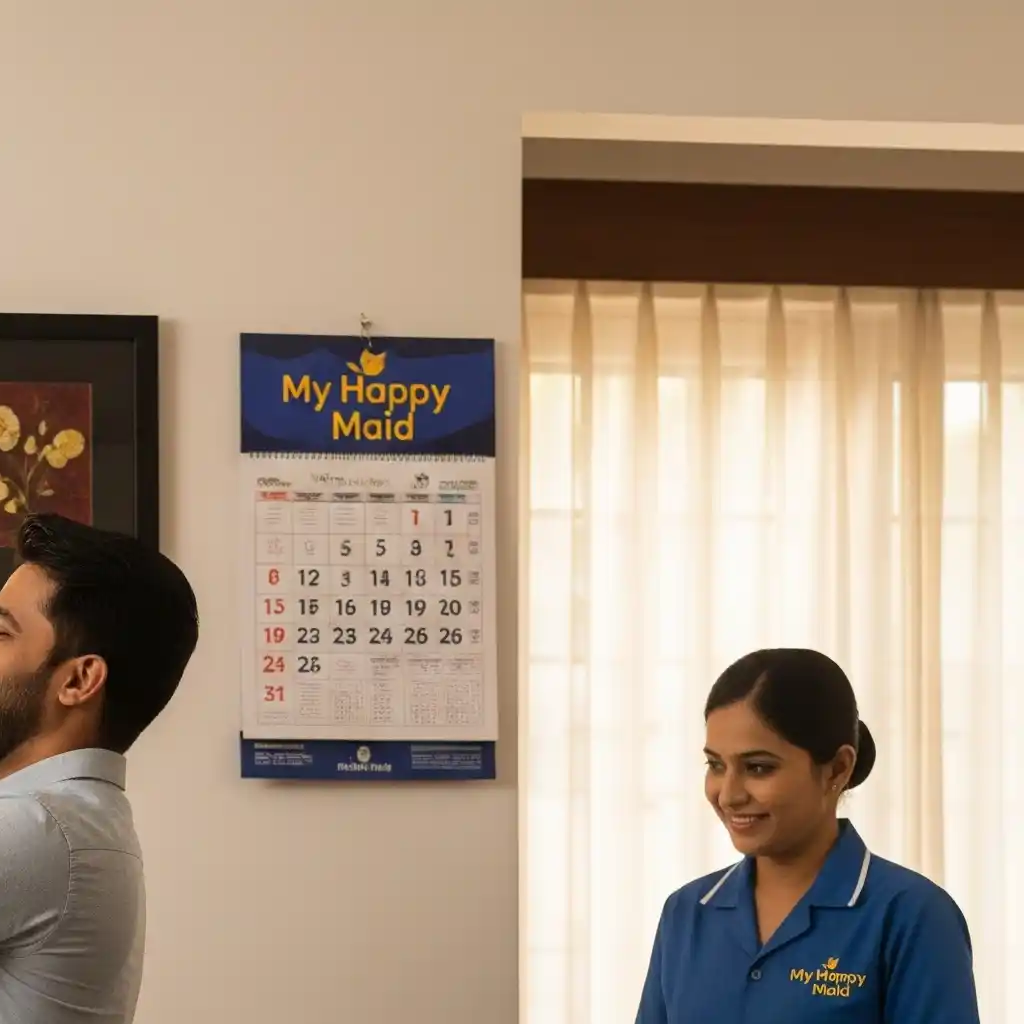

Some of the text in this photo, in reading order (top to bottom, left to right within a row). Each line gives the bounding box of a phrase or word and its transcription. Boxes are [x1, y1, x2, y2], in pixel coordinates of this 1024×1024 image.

[282, 374, 451, 415] My Happy
[332, 410, 415, 440] Maid
[444, 509, 453, 527] 1
[375, 538, 387, 557] 5
[298, 568, 320, 587] 12
[440, 569, 462, 588] 15
[405, 599, 427, 617] 19
[438, 598, 462, 617] 20
[332, 626, 357, 645] 23
[368, 627, 393, 645] 24
[403, 627, 429, 645] 26
[439, 627, 463, 645] 26
[262, 655, 285, 673] 24
[264, 685, 284, 702] 31
[790, 968, 813, 985] My
